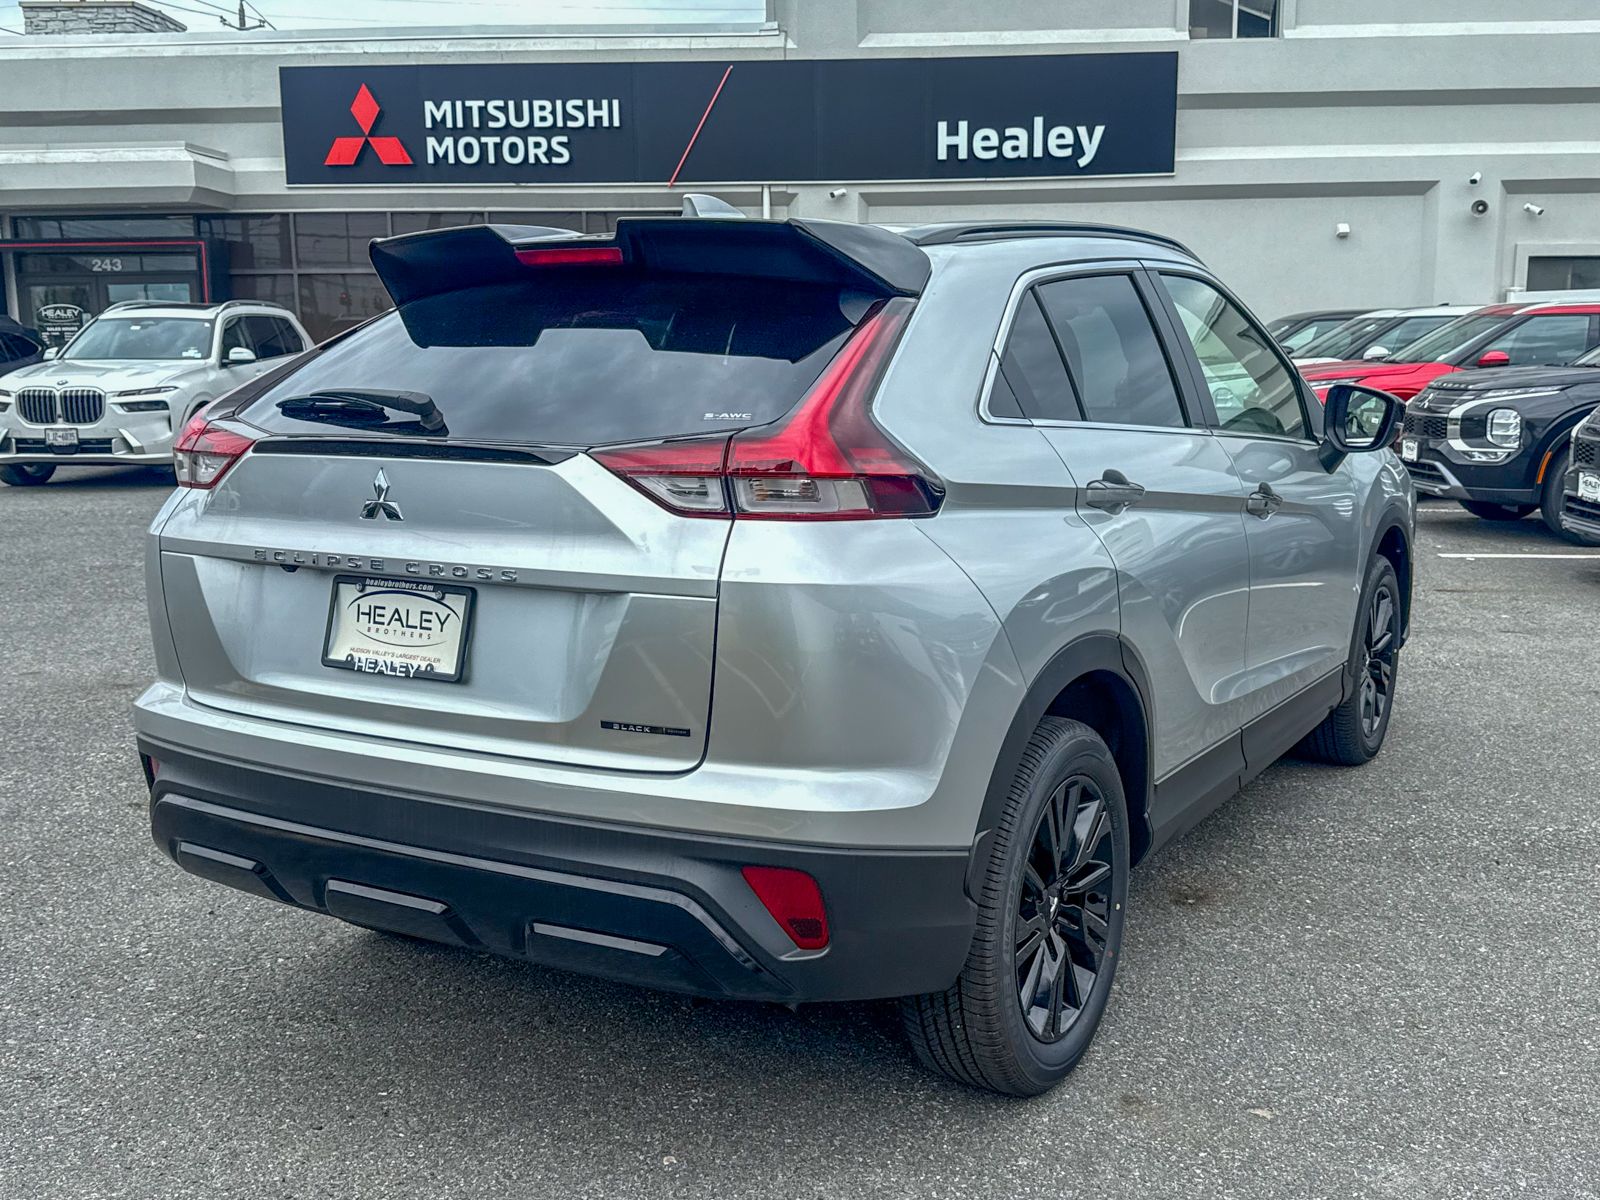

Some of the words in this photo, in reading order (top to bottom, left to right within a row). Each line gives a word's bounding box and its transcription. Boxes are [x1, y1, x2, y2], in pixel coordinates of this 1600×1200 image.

[423, 98, 621, 129] MITSUBISHI
[426, 135, 571, 166] MOTORS
[936, 116, 1106, 168] Healey
[92, 258, 123, 272] 243
[41, 309, 80, 317] HEALEY
[254, 549, 384, 570] ECLIPSE
[405, 562, 518, 582] CROSS
[365, 578, 434, 592] healeybrothers.com
[356, 603, 451, 633] HEALEY
[367, 626, 432, 640] BROTHERS
[350, 647, 371, 655] HUDSON
[372, 649, 395, 658] VALLEY'S
[395, 652, 420, 661] LARGEST
[420, 655, 442, 664] DEALER
[354, 656, 419, 678] HEALEY
[612, 723, 651, 733] BLACK
